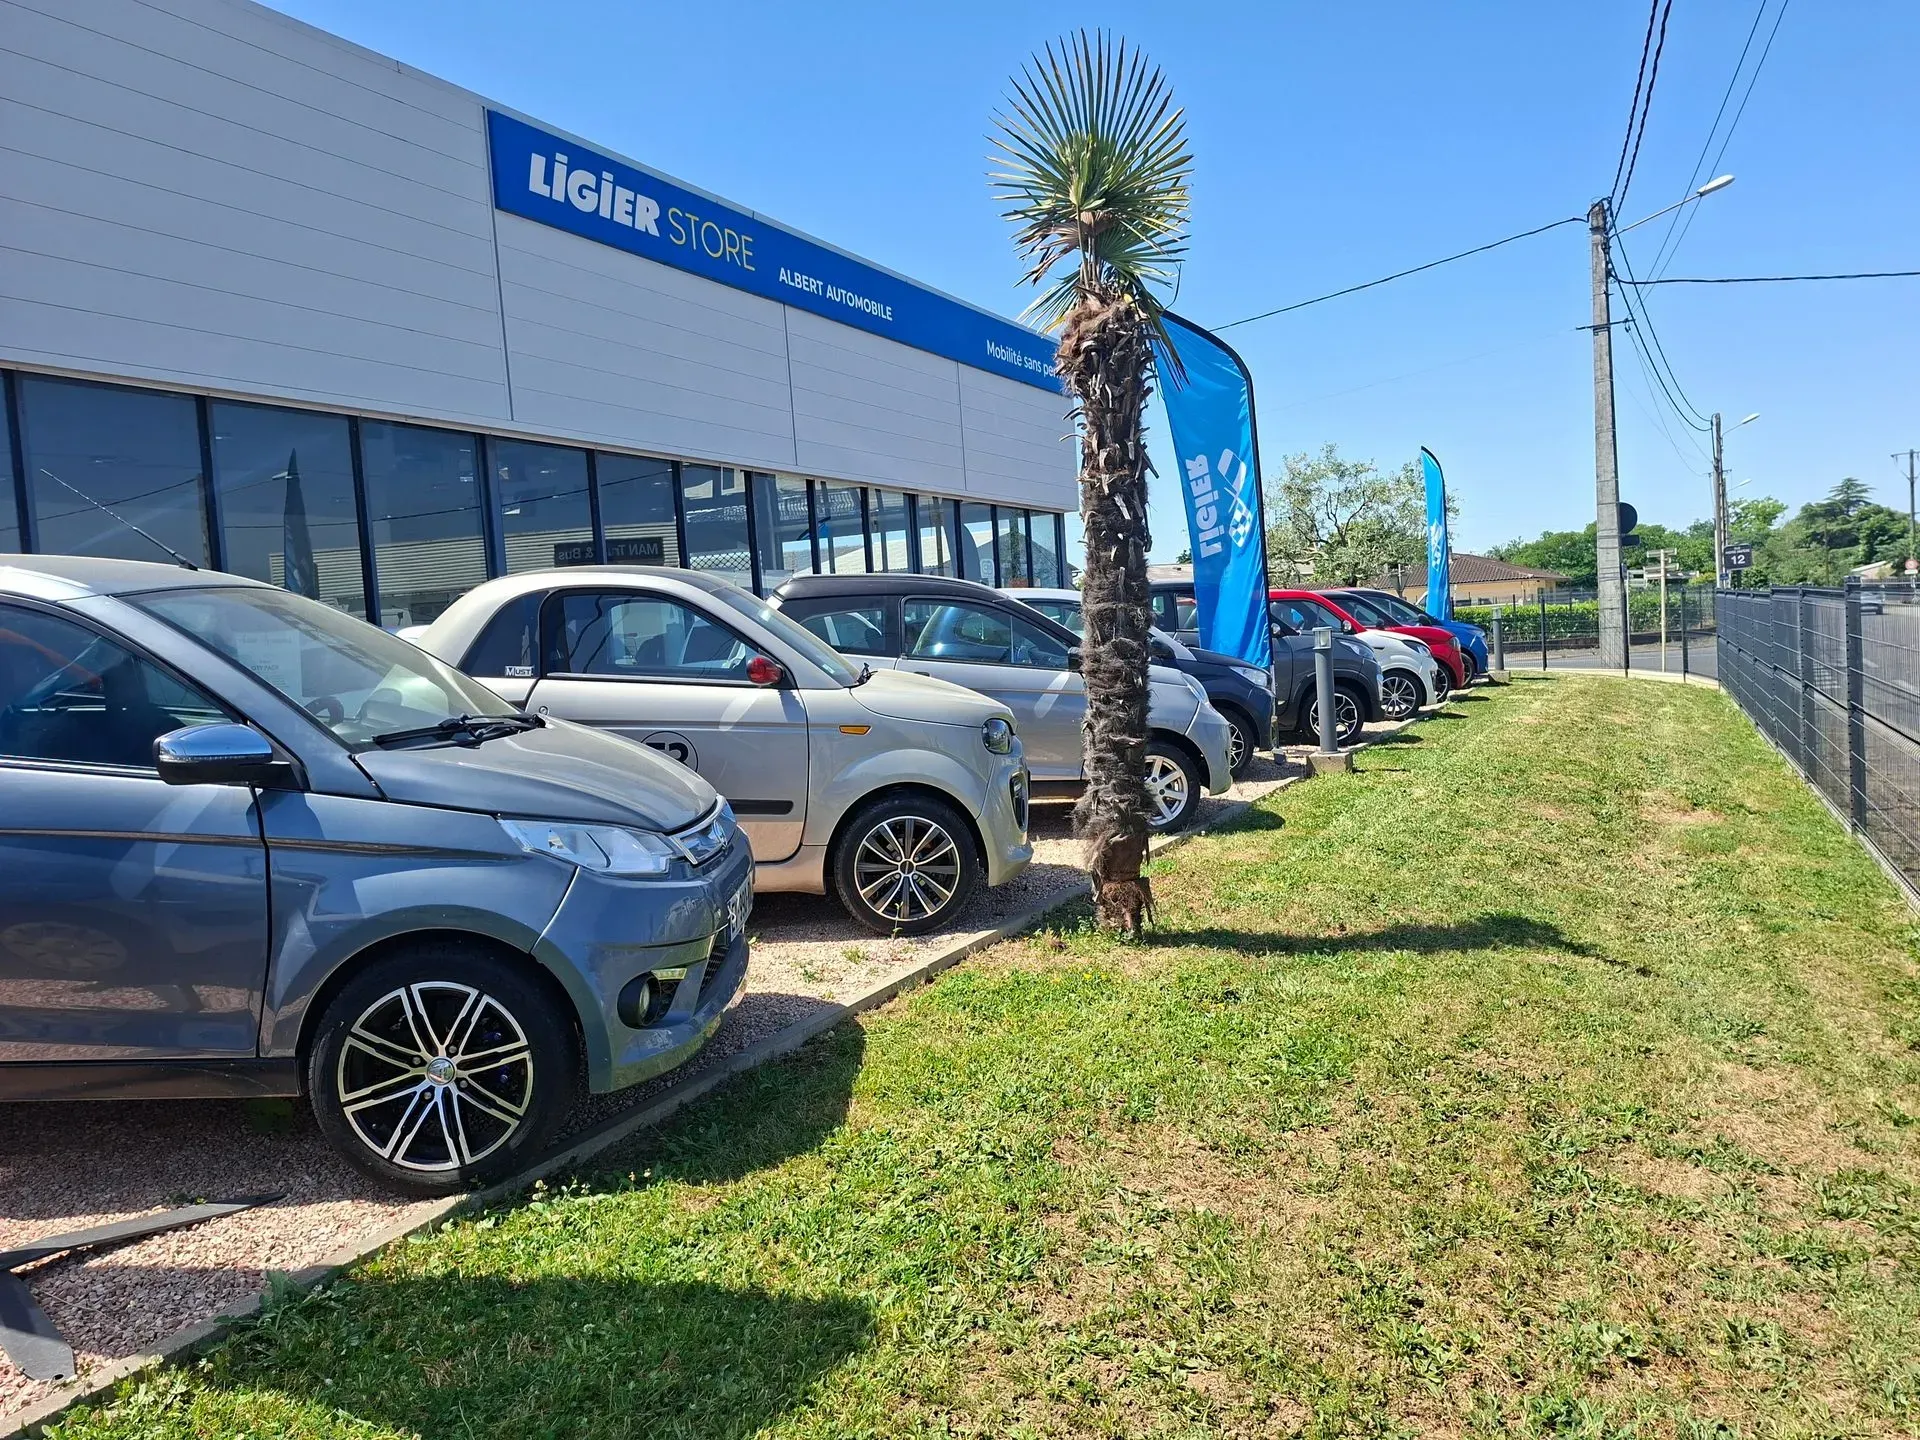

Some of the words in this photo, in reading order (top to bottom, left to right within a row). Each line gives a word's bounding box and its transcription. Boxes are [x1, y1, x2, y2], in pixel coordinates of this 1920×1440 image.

[668, 207, 756, 271] STORE
[779, 266, 824, 296] ALBERT
[826, 284, 893, 321] AUTOMOBILE
[986, 339, 1022, 367] Mobilité
[1023, 355, 1042, 373] sans
[1731, 554, 1745, 564] 12
